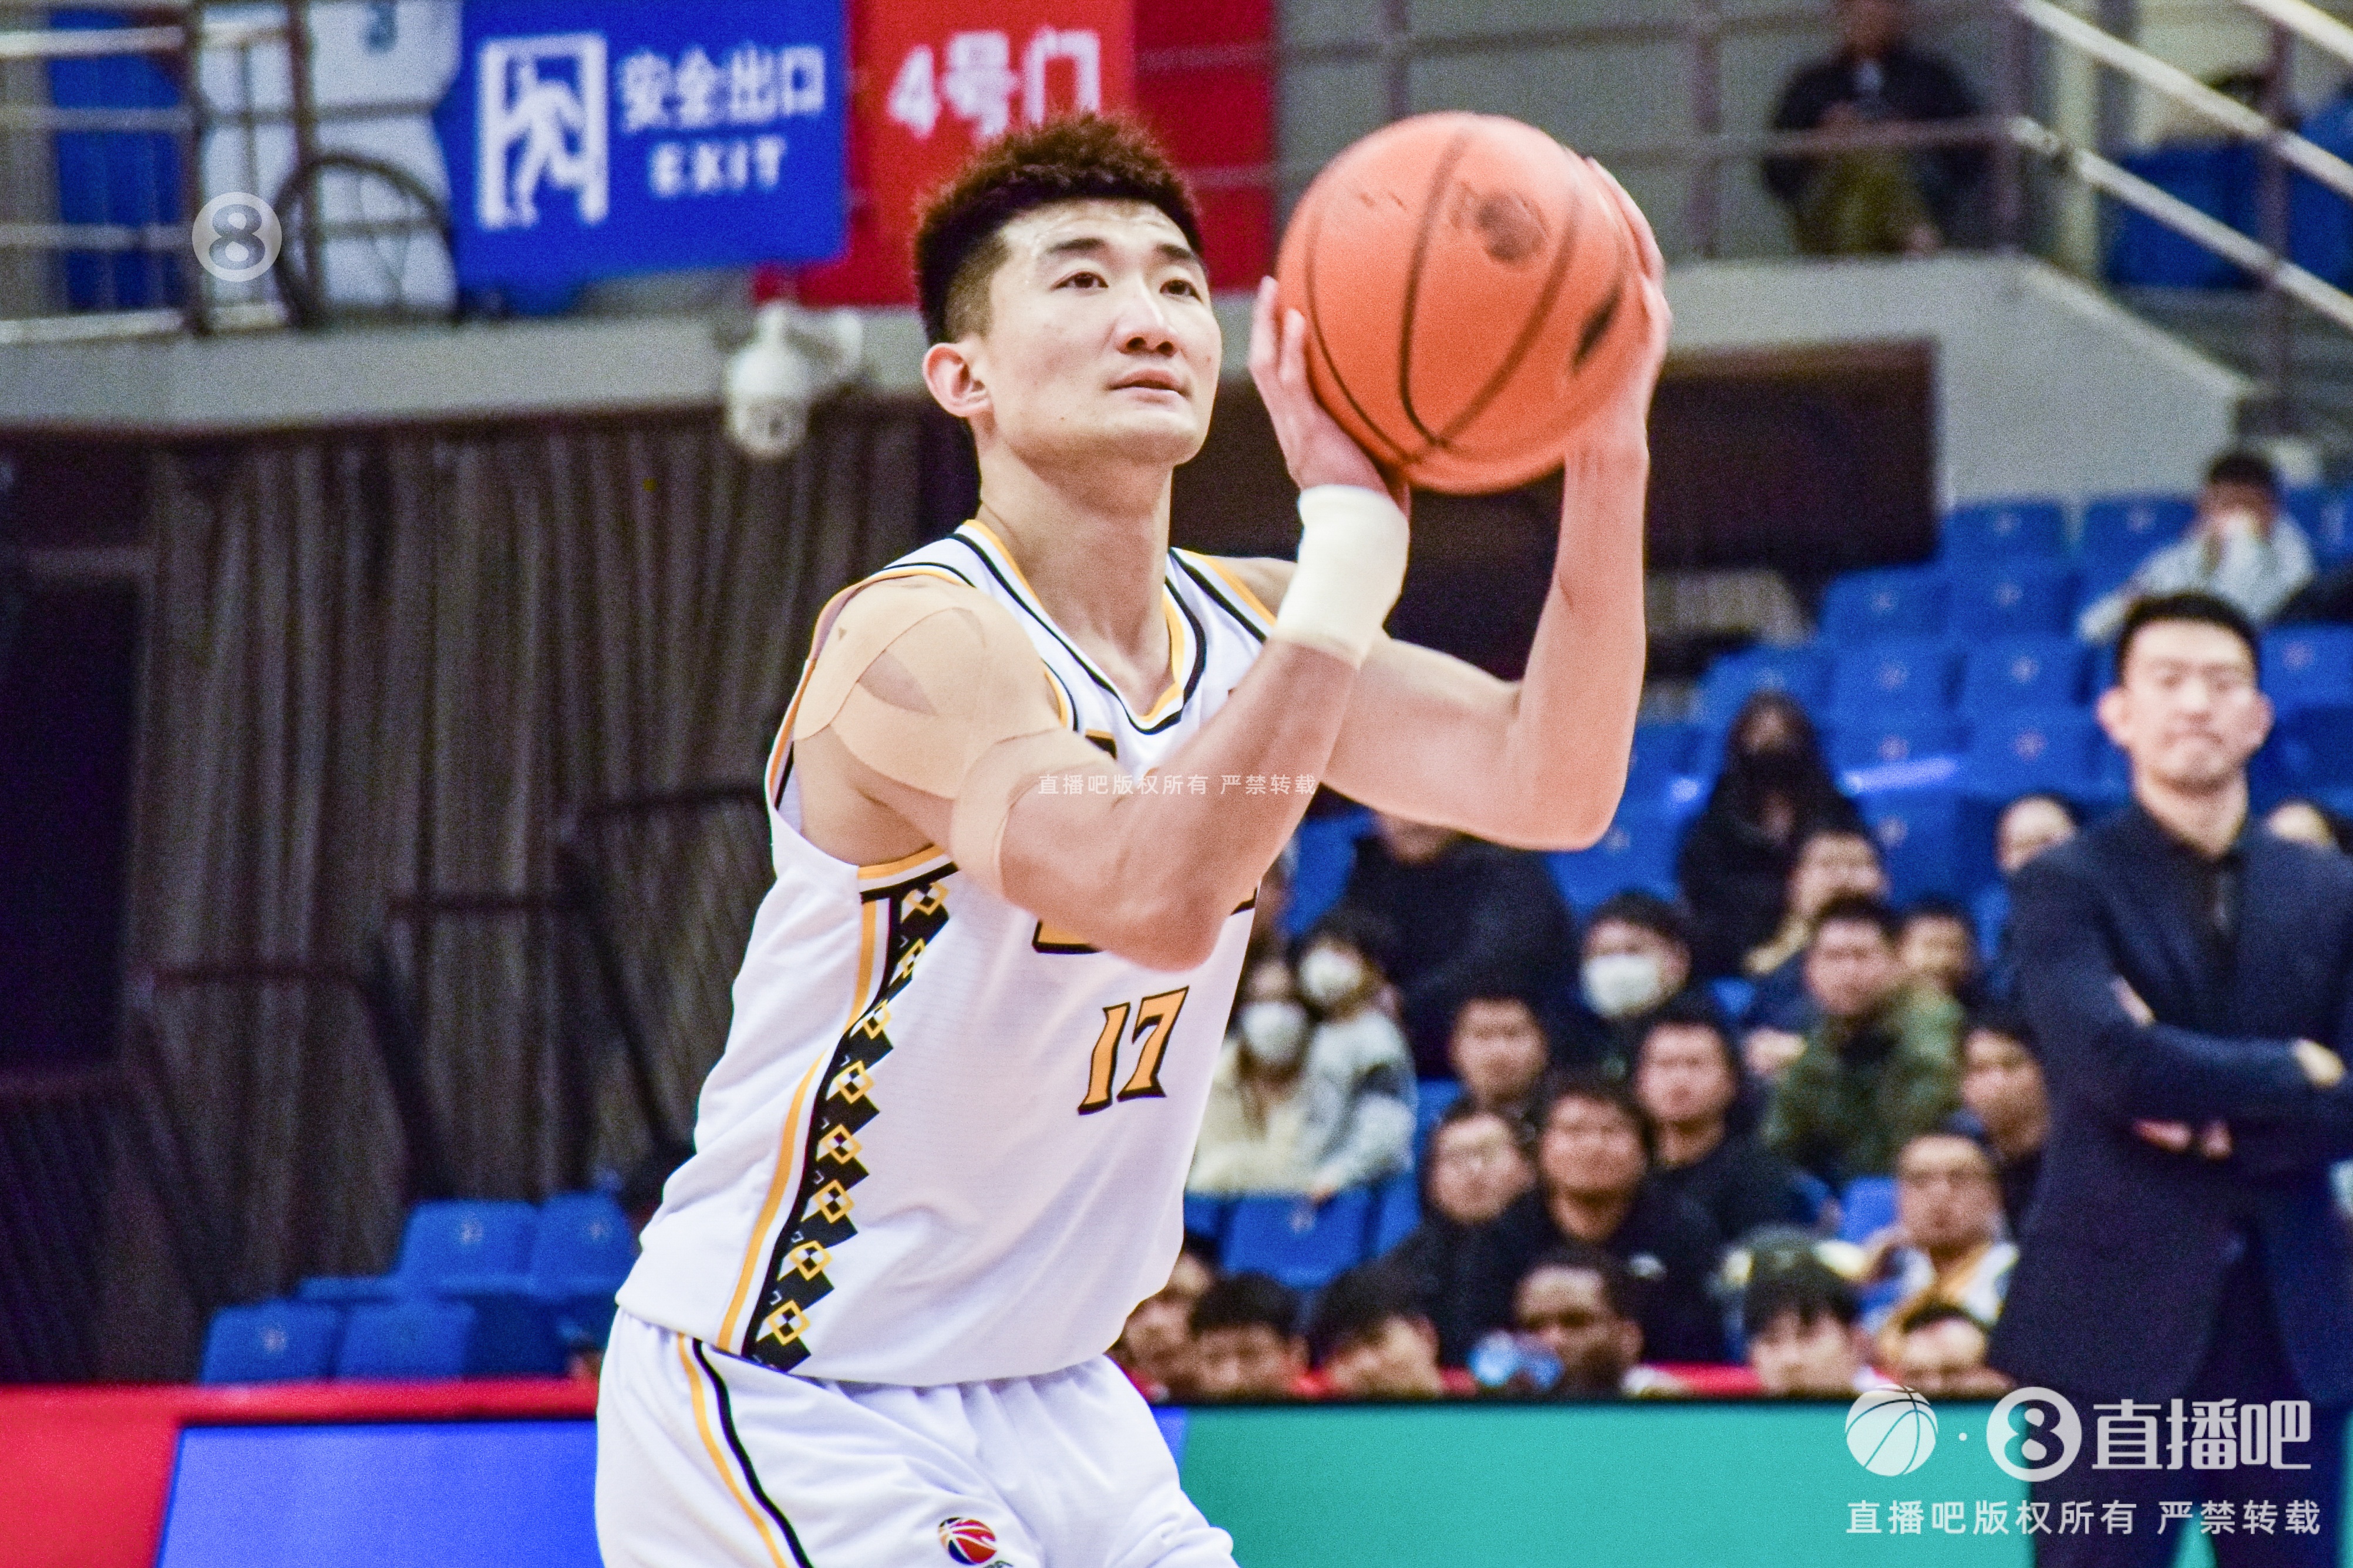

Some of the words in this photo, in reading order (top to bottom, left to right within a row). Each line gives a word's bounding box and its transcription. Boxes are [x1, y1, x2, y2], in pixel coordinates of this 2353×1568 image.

[619, 41, 826, 133] 安全出口
[888, 27, 1102, 140] 4号门
[649, 136, 785, 198] EXIT
[1078, 986, 1189, 1115] 17
